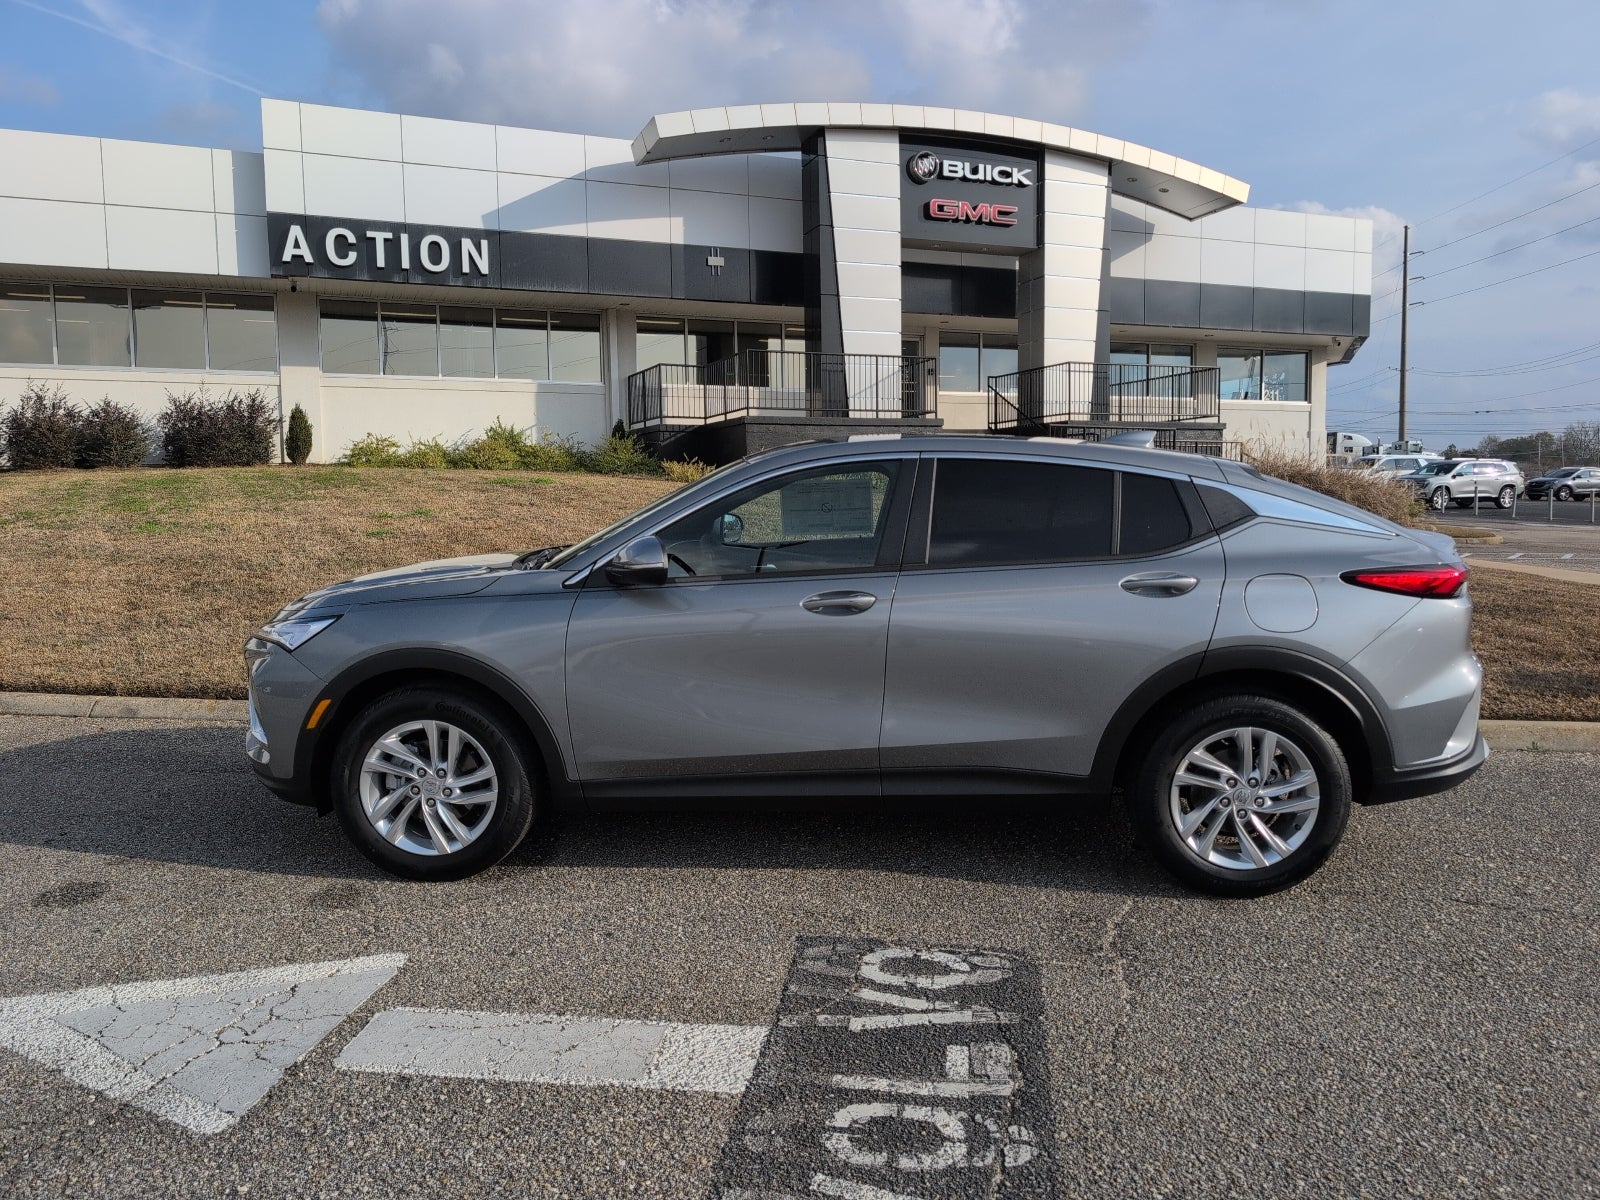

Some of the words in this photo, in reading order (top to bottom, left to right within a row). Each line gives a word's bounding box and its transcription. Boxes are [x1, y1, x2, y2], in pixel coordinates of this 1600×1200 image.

[942, 159, 1033, 185] BUICK
[930, 198, 1018, 224] GMC
[281, 224, 490, 276] ACTION
[806, 947, 1016, 1200] OLVO
